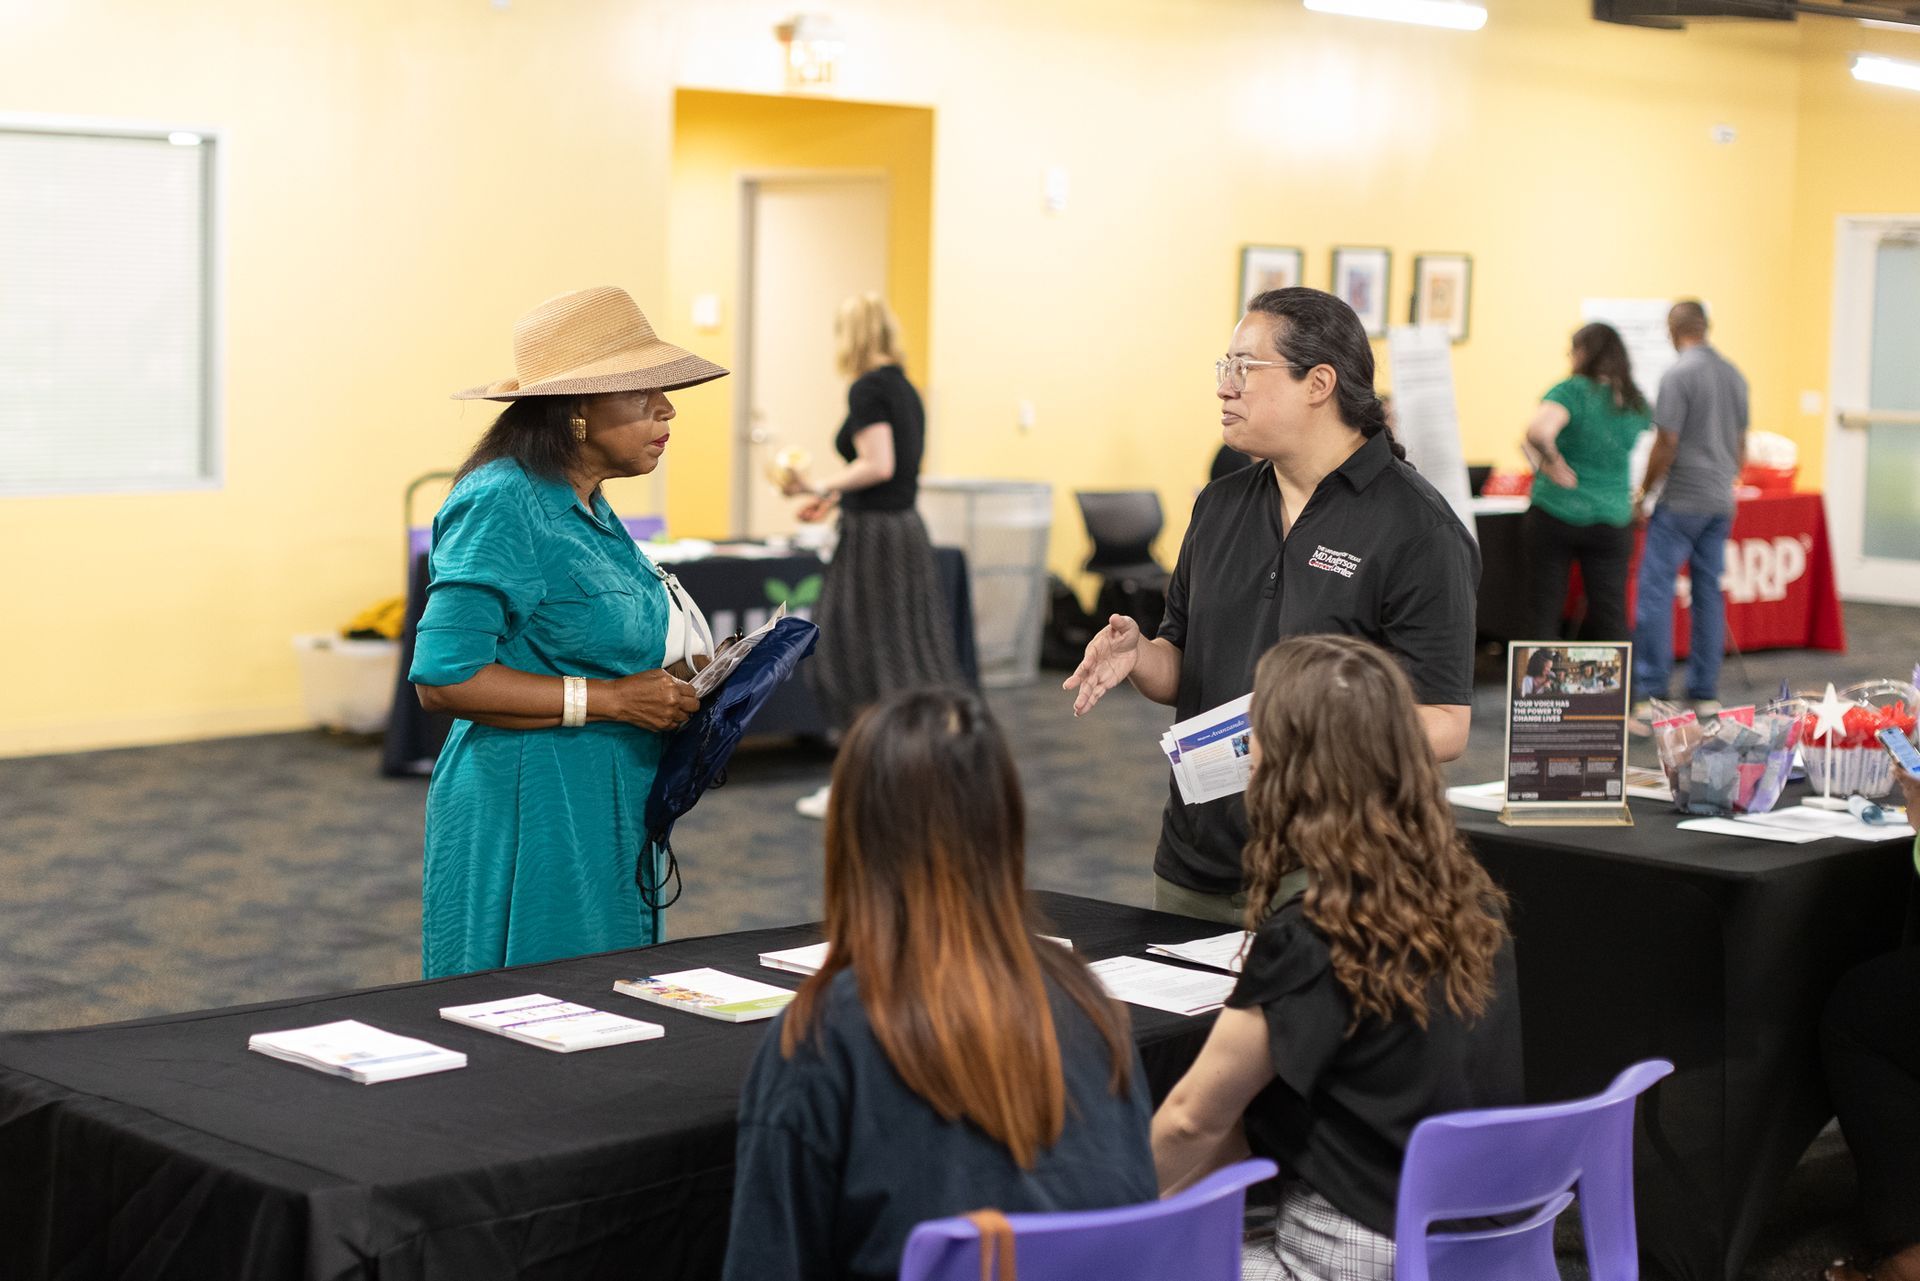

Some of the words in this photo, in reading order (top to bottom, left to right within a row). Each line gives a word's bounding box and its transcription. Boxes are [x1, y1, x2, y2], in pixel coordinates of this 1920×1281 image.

[1312, 549, 1327, 561] MD
[1676, 536, 1806, 608] ARP
[1513, 699, 1533, 708] YOUR
[1533, 699, 1555, 708] VOICE
[1555, 699, 1570, 708] HAS
[1513, 707, 1527, 716] THE
[1527, 707, 1552, 716] POWER
[1552, 708, 1563, 716] TO
[1512, 715, 1542, 723] CHANGE
[1542, 715, 1561, 723] LIVES
